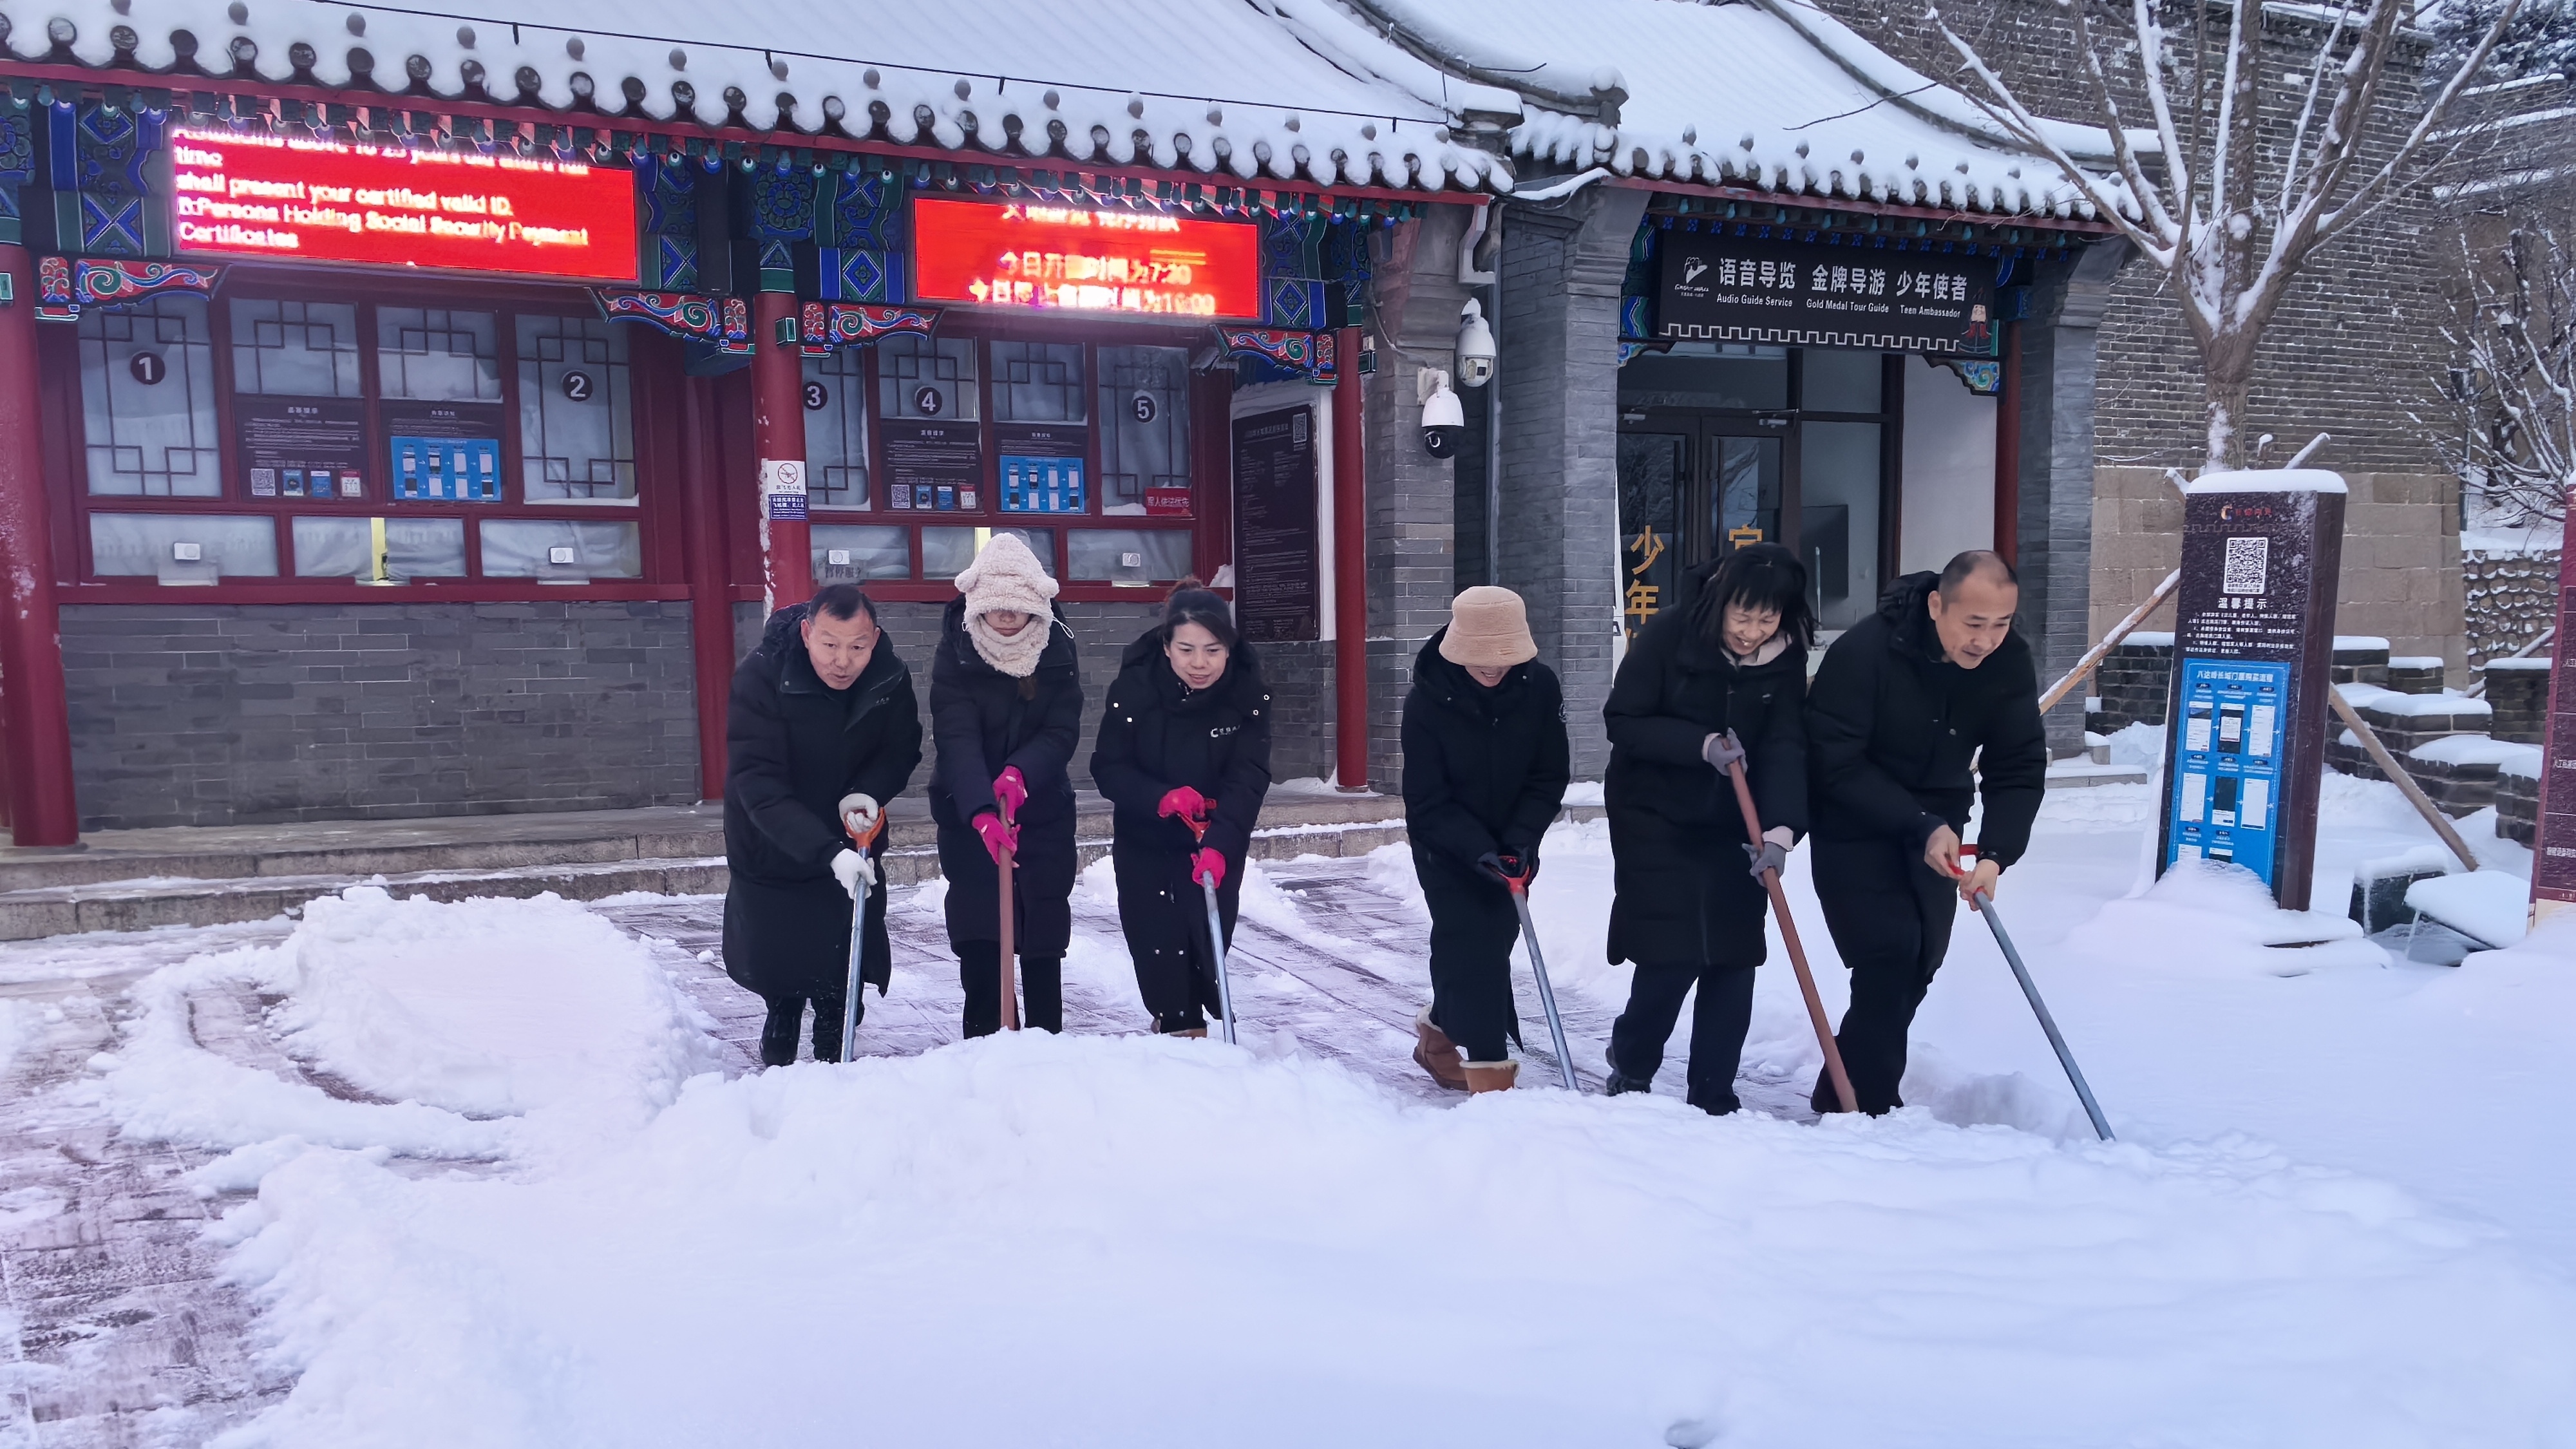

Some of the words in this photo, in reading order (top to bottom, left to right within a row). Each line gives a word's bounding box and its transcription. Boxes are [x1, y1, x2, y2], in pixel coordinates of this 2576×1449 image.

[175, 171, 225, 192] shall
[308, 185, 352, 204] your
[355, 187, 437, 210] certified
[440, 194, 486, 214] valid
[179, 221, 299, 249] Certificates
[283, 204, 362, 233] Holding
[365, 211, 426, 233] Social
[430, 216, 506, 244] Security
[1719, 258, 1796, 289] 语音导览
[1812, 264, 1886, 296] 金牌导游
[1897, 270, 1967, 301] 少年使者
[1717, 293, 1739, 304] Audio
[1741, 294, 1763, 305] Guide
[1765, 296, 1793, 307] Service
[1806, 298, 1824, 308] Gold
[1825, 299, 1848, 310] Medal
[1850, 301, 1867, 312] Tour
[1868, 303, 1889, 313] Guide
[1900, 305, 1917, 315] Teen
[1918, 306, 1961, 318] Ambassador
[139, 356, 152, 381] 1
[570, 375, 585, 397] 2
[807, 385, 820, 406] 3
[922, 391, 936, 412] 4
[1137, 400, 1150, 419] 5
